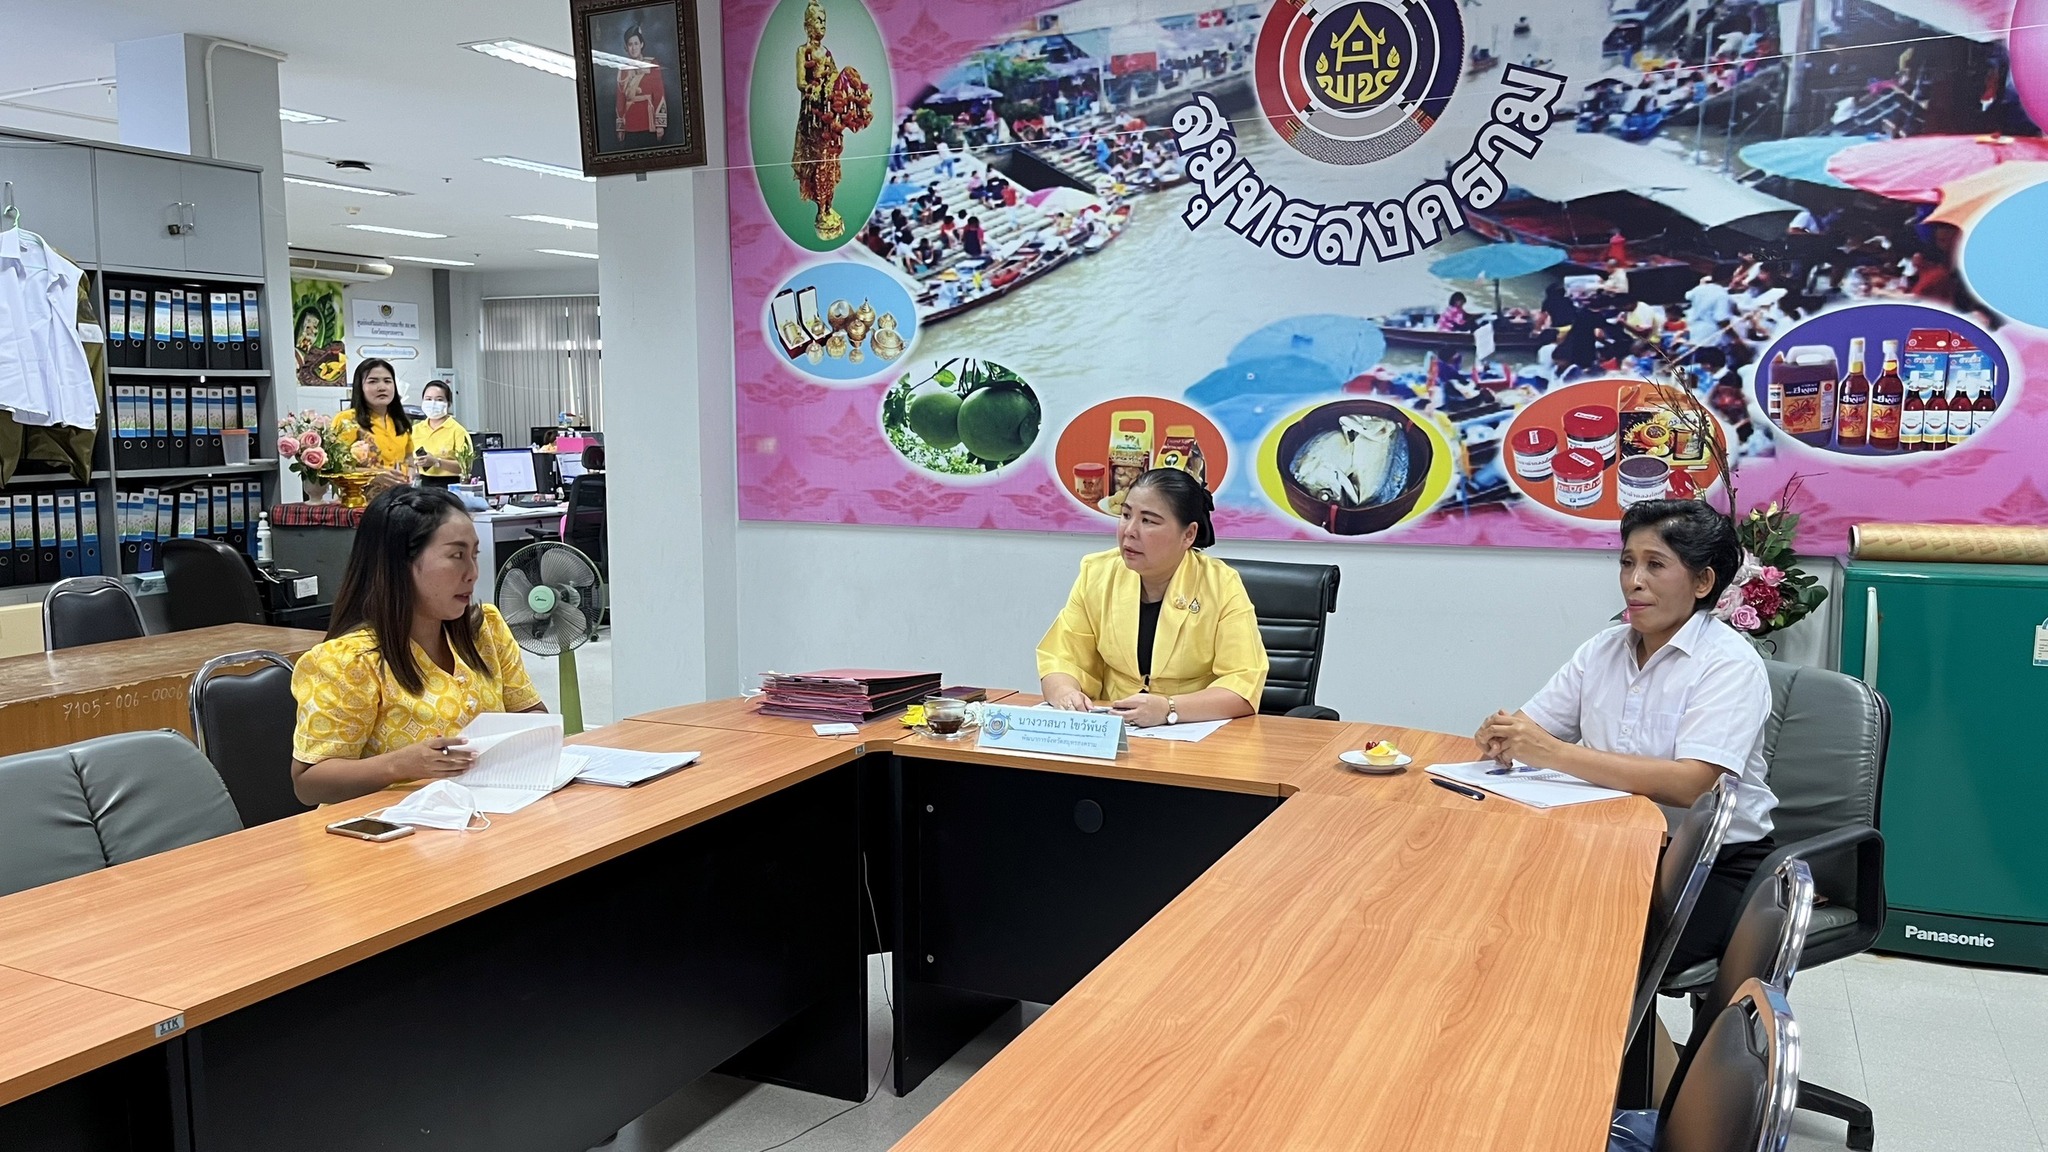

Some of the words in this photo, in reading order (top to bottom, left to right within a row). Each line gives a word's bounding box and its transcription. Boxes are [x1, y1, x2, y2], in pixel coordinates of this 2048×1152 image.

[1172, 63, 1568, 266] สมุทรสงคราม
[1019, 717, 1066, 729] นางวาสนา
[1905, 925, 1995, 948] Panasonic
